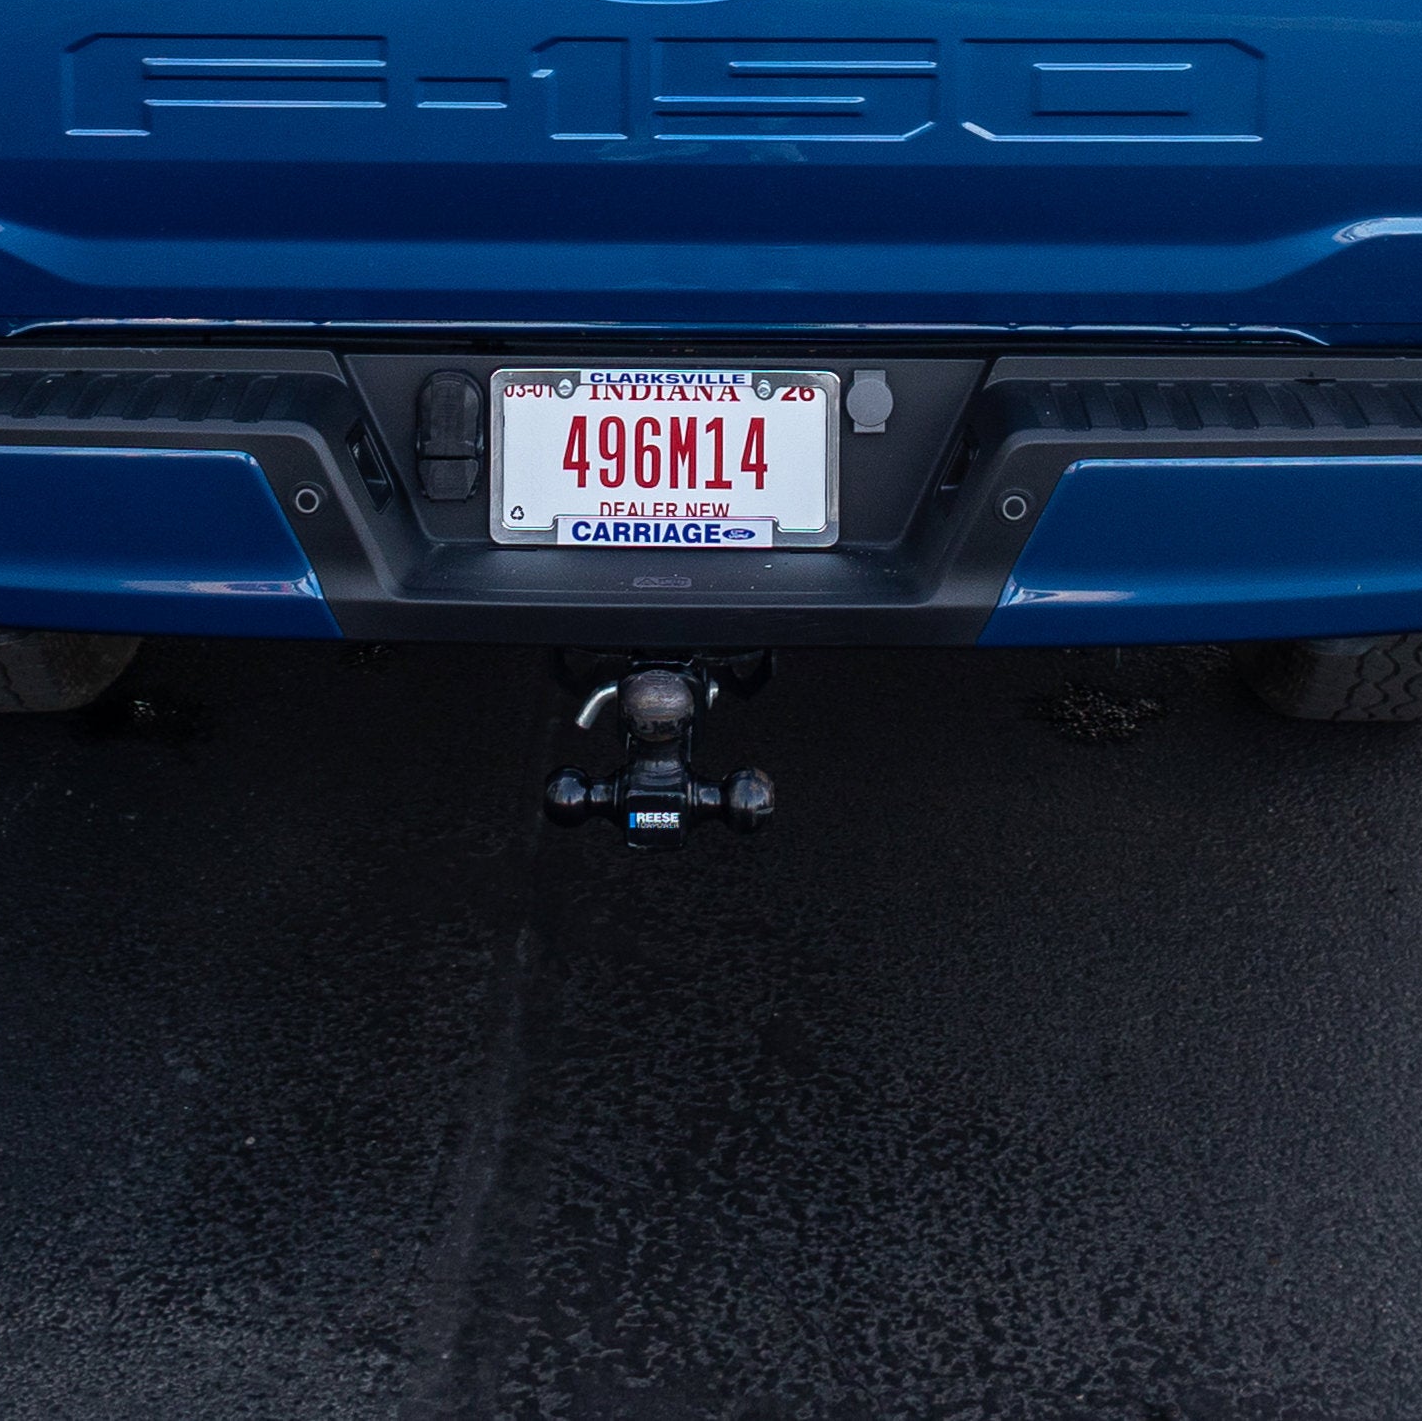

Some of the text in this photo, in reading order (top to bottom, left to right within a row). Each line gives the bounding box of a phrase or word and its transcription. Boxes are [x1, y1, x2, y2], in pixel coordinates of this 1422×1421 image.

[64, 31, 1267, 143] F-150
[589, 372, 747, 385] CLARKSVILLE
[588, 384, 741, 402] INDIANA
[781, 386, 817, 402] 26
[562, 415, 769, 490] 496M14
[599, 501, 730, 517] DEALER NEW
[571, 520, 750, 544] CARRIAGE Ford
[636, 812, 680, 823] REESE
